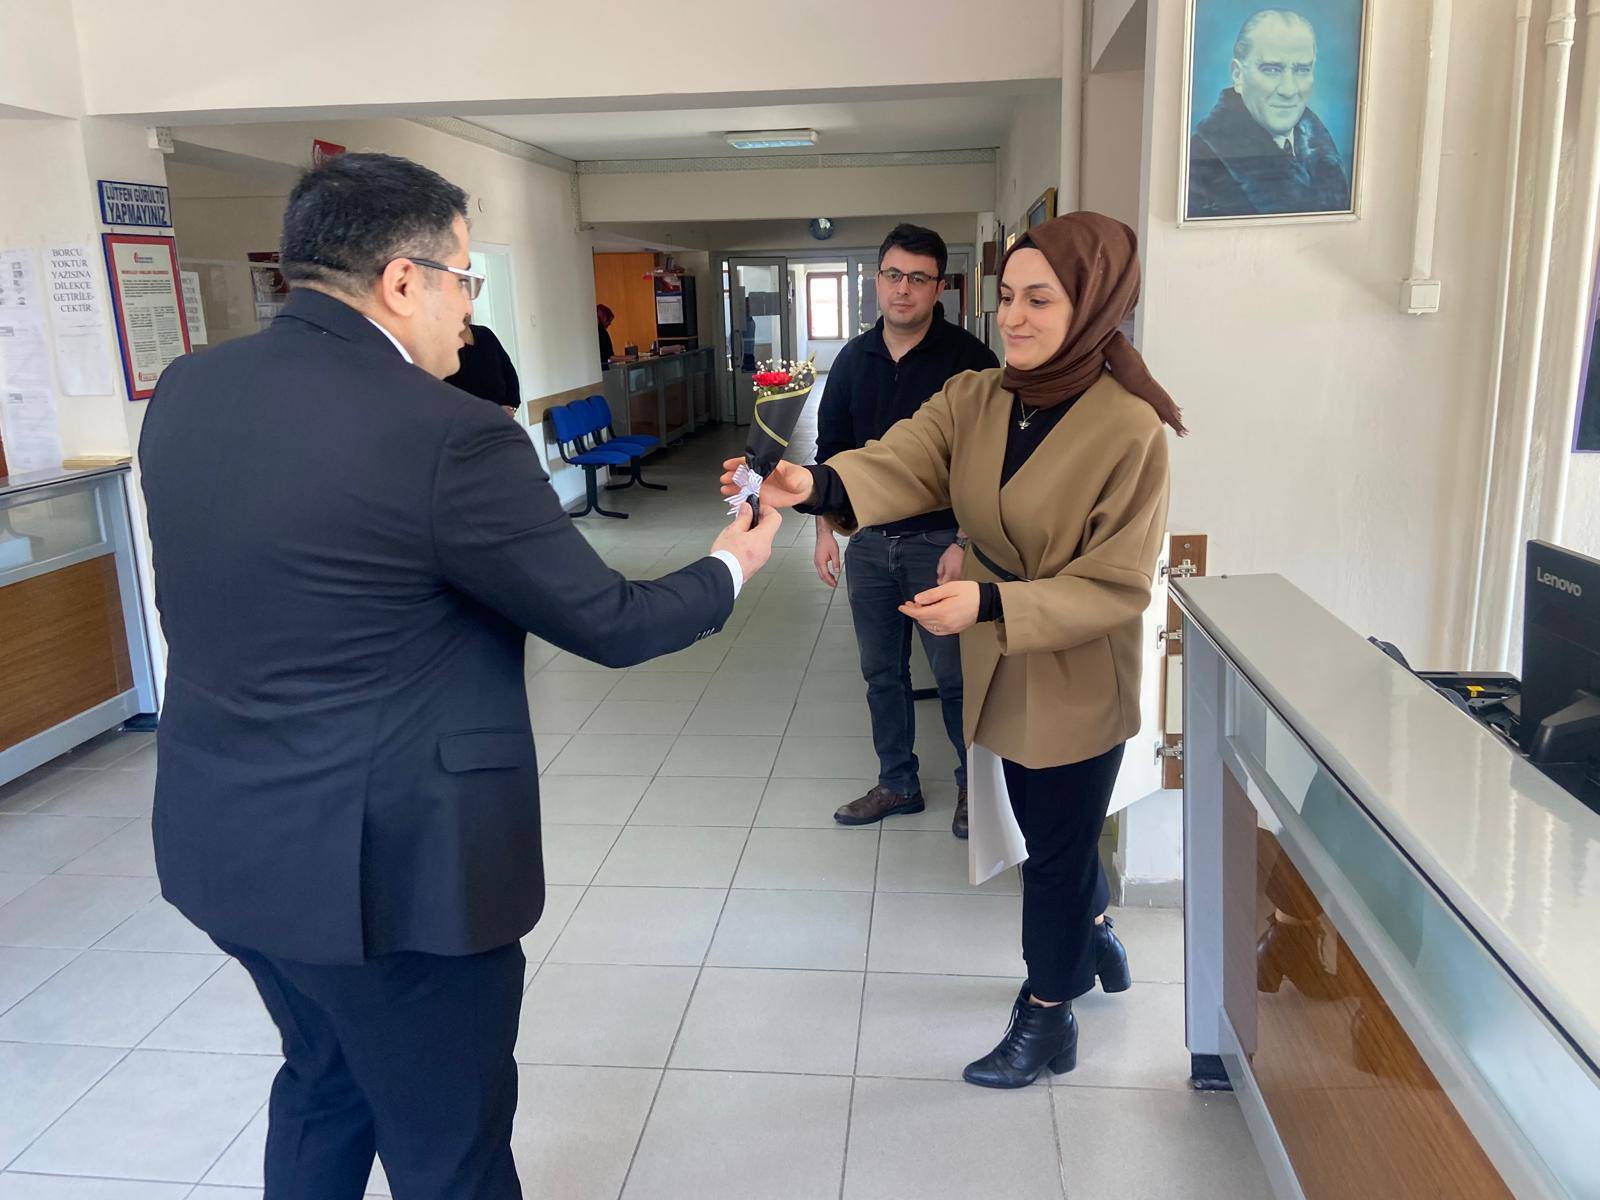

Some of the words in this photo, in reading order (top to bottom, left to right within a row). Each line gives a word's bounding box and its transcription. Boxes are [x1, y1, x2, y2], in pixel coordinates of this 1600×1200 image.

[105, 185, 133, 202] LÜTFEN
[134, 188, 165, 204] GÜRÜLTÜ
[108, 203, 167, 225] YAPMAYINIZ
[52, 248, 82, 257] BORCU
[51, 259, 88, 268] YOKTUR
[52, 270, 91, 279] YAZISINA
[1537, 566, 1582, 597] Lenovo
